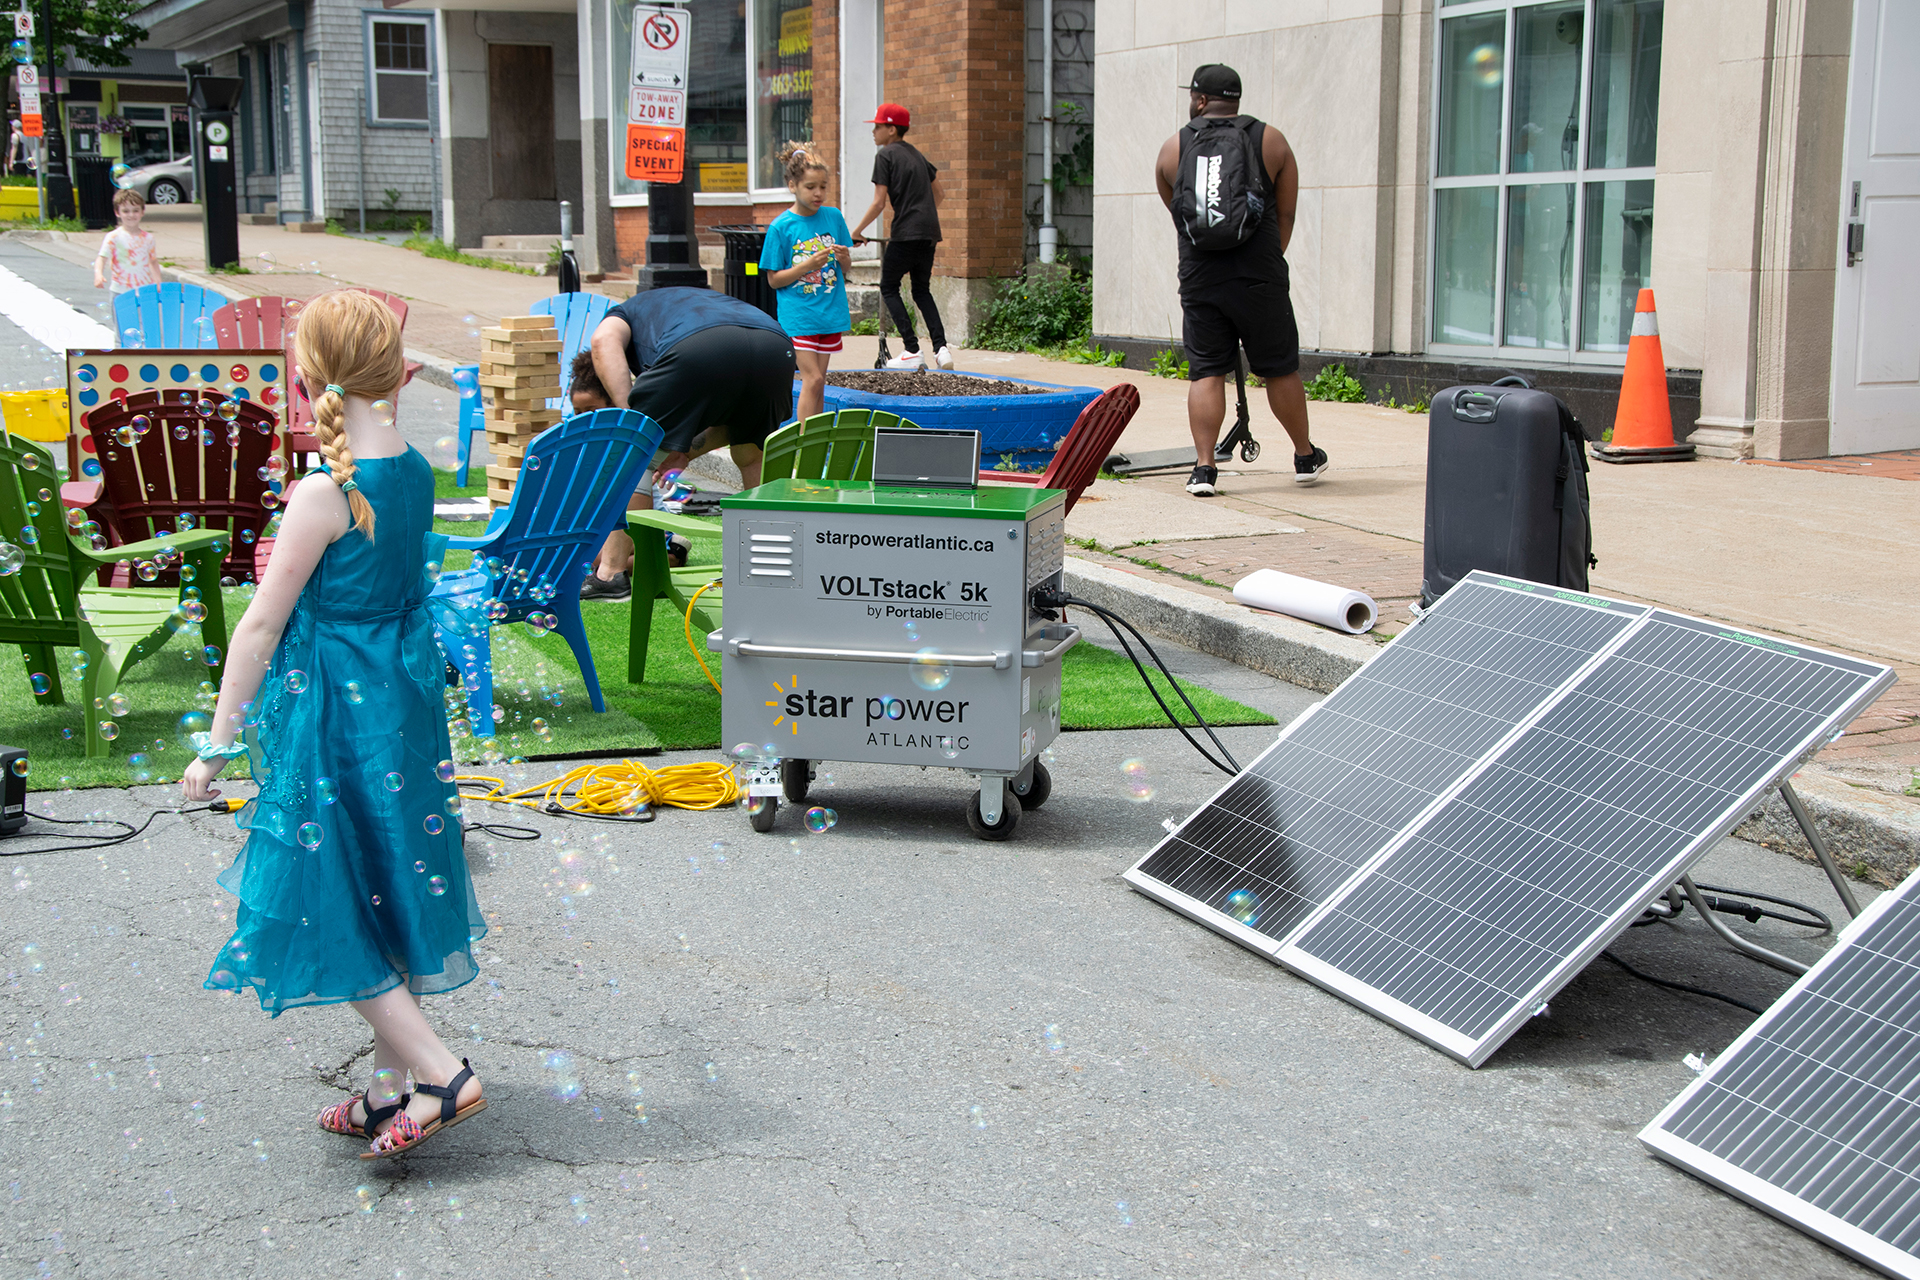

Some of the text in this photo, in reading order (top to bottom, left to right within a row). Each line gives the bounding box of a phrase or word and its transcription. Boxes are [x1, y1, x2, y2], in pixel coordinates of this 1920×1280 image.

[778, 34, 808, 57] PAWNS
[637, 92, 679, 103] TOW-AWAY
[639, 104, 675, 120] ZONE
[632, 138, 679, 152] SPECIAL
[635, 156, 675, 170] EVENT
[1207, 154, 1222, 207] Reebok
[815, 530, 995, 552] starpoweratlantic.ca
[960, 582, 988, 602] 5k
[1553, 591, 1611, 608] PORTABLE SOLAR
[867, 604, 882, 619] by
[785, 689, 970, 727] star power
[866, 732, 970, 750] ATLANTIC
